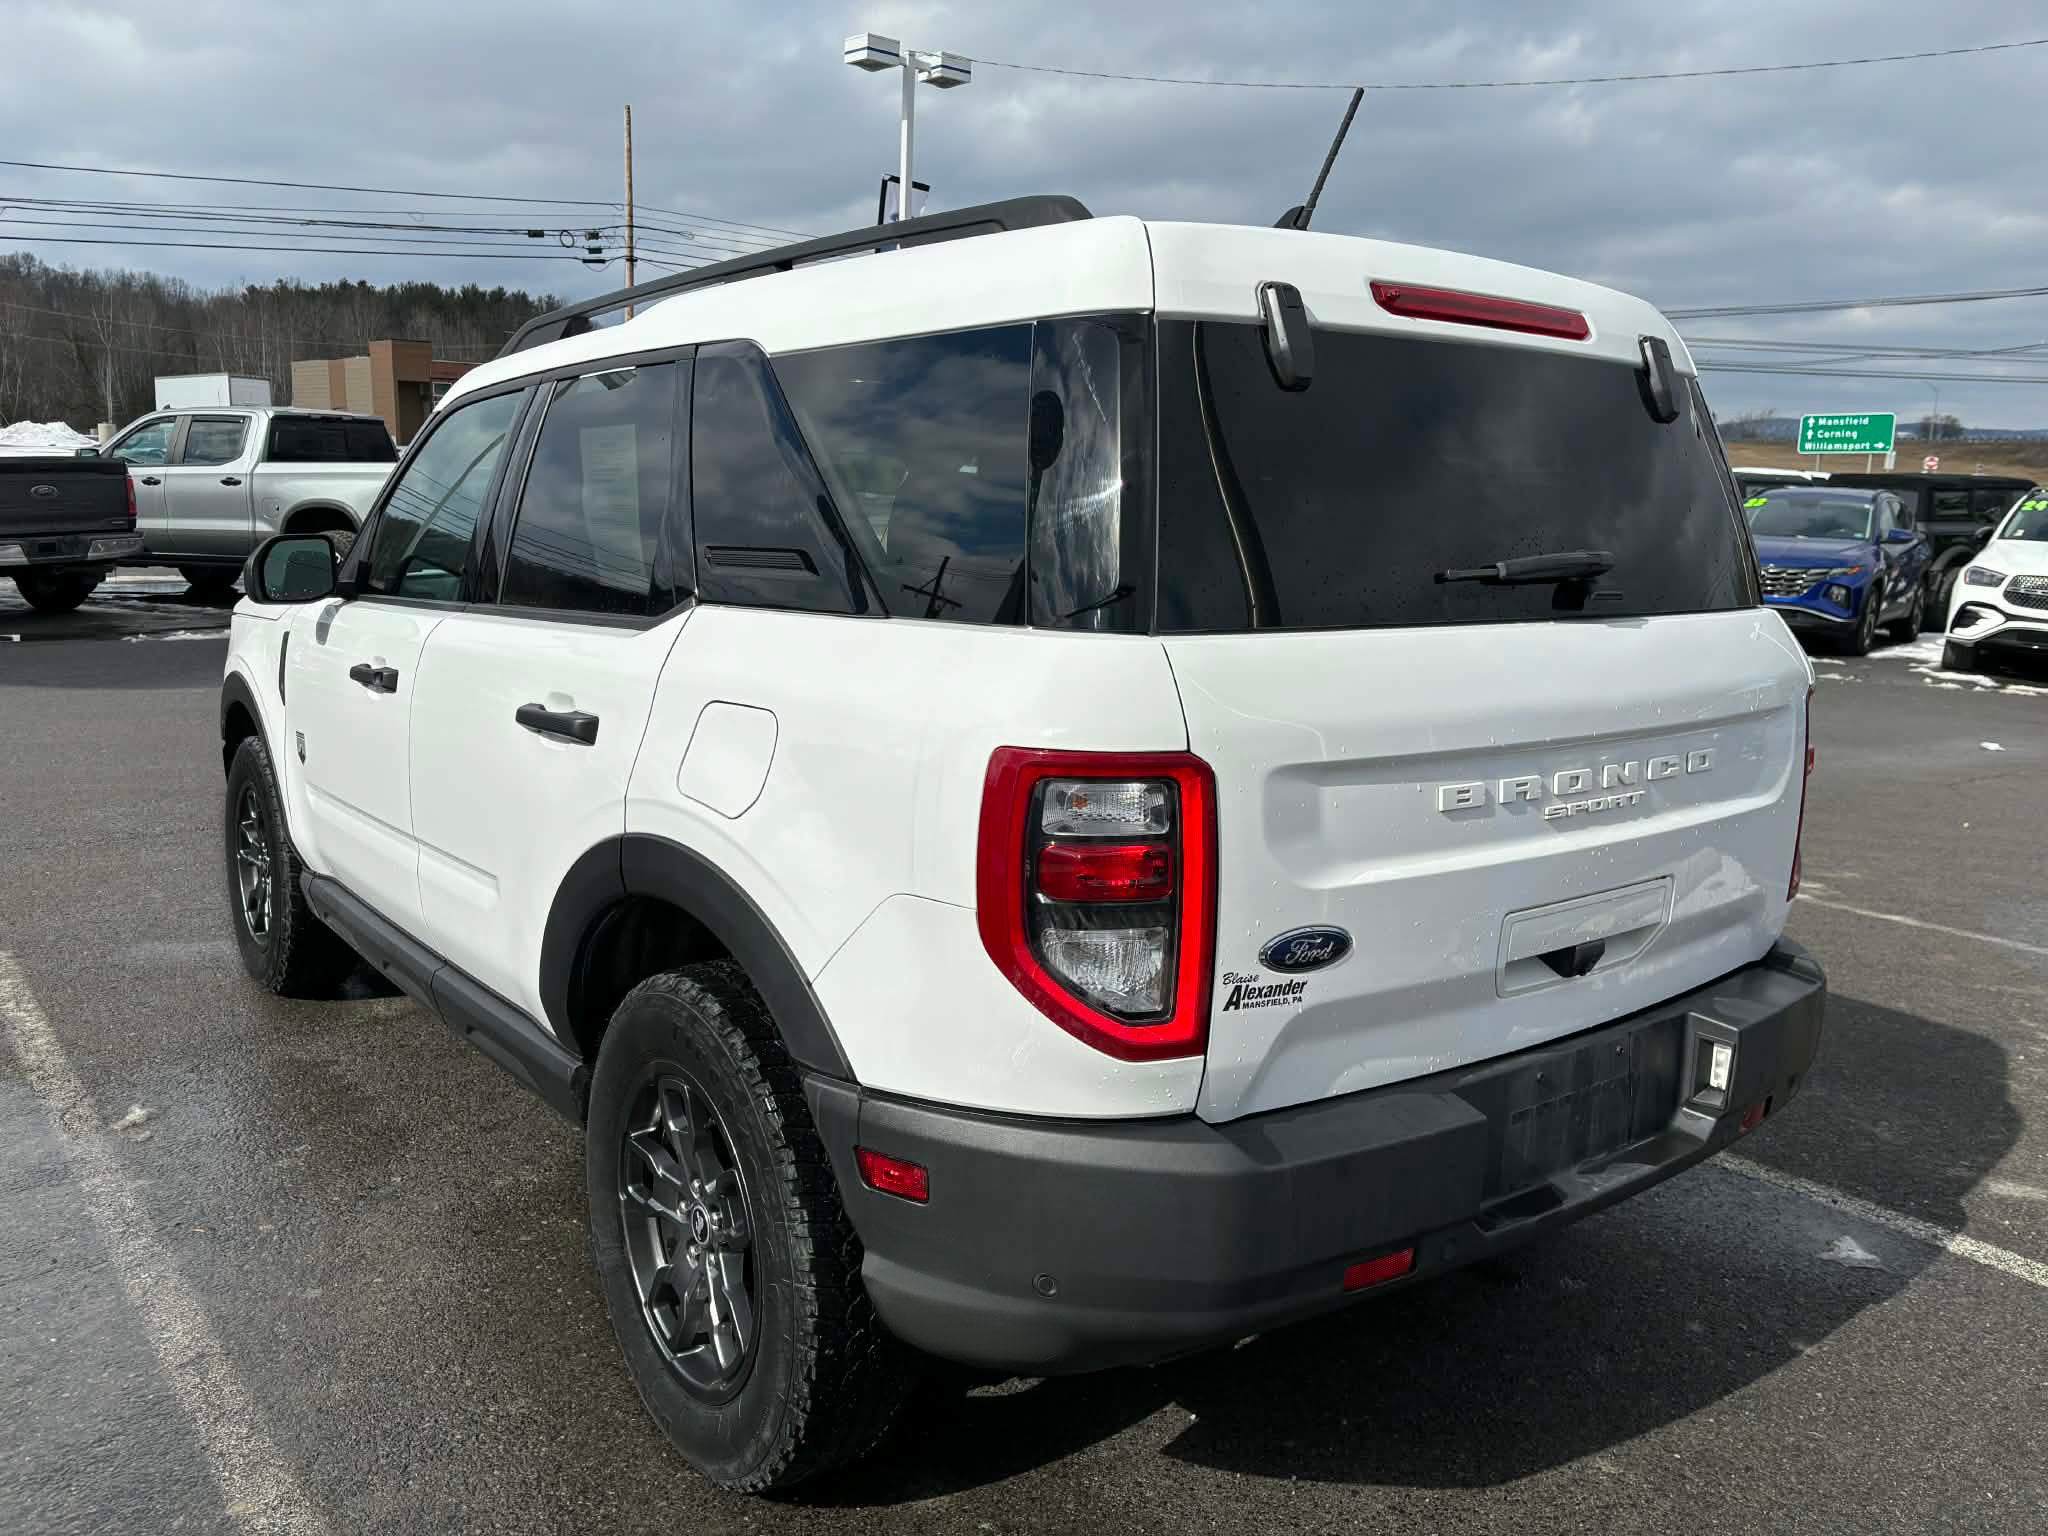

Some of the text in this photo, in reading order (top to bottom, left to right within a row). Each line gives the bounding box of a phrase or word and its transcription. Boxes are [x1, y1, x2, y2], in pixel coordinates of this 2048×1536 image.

[1818, 416, 1869, 426] Mansfield
[1817, 429, 1858, 439] Corning
[1804, 442, 1870, 451] Williamsport
[1438, 748, 1713, 812] BRONCO
[1544, 790, 1646, 820] SPORT
[1284, 937, 1335, 965] Ford
[1222, 972, 1260, 985] Blaise
[1222, 979, 1308, 1012] Alexander
[1242, 998, 1291, 1009] MANSFIELD,
